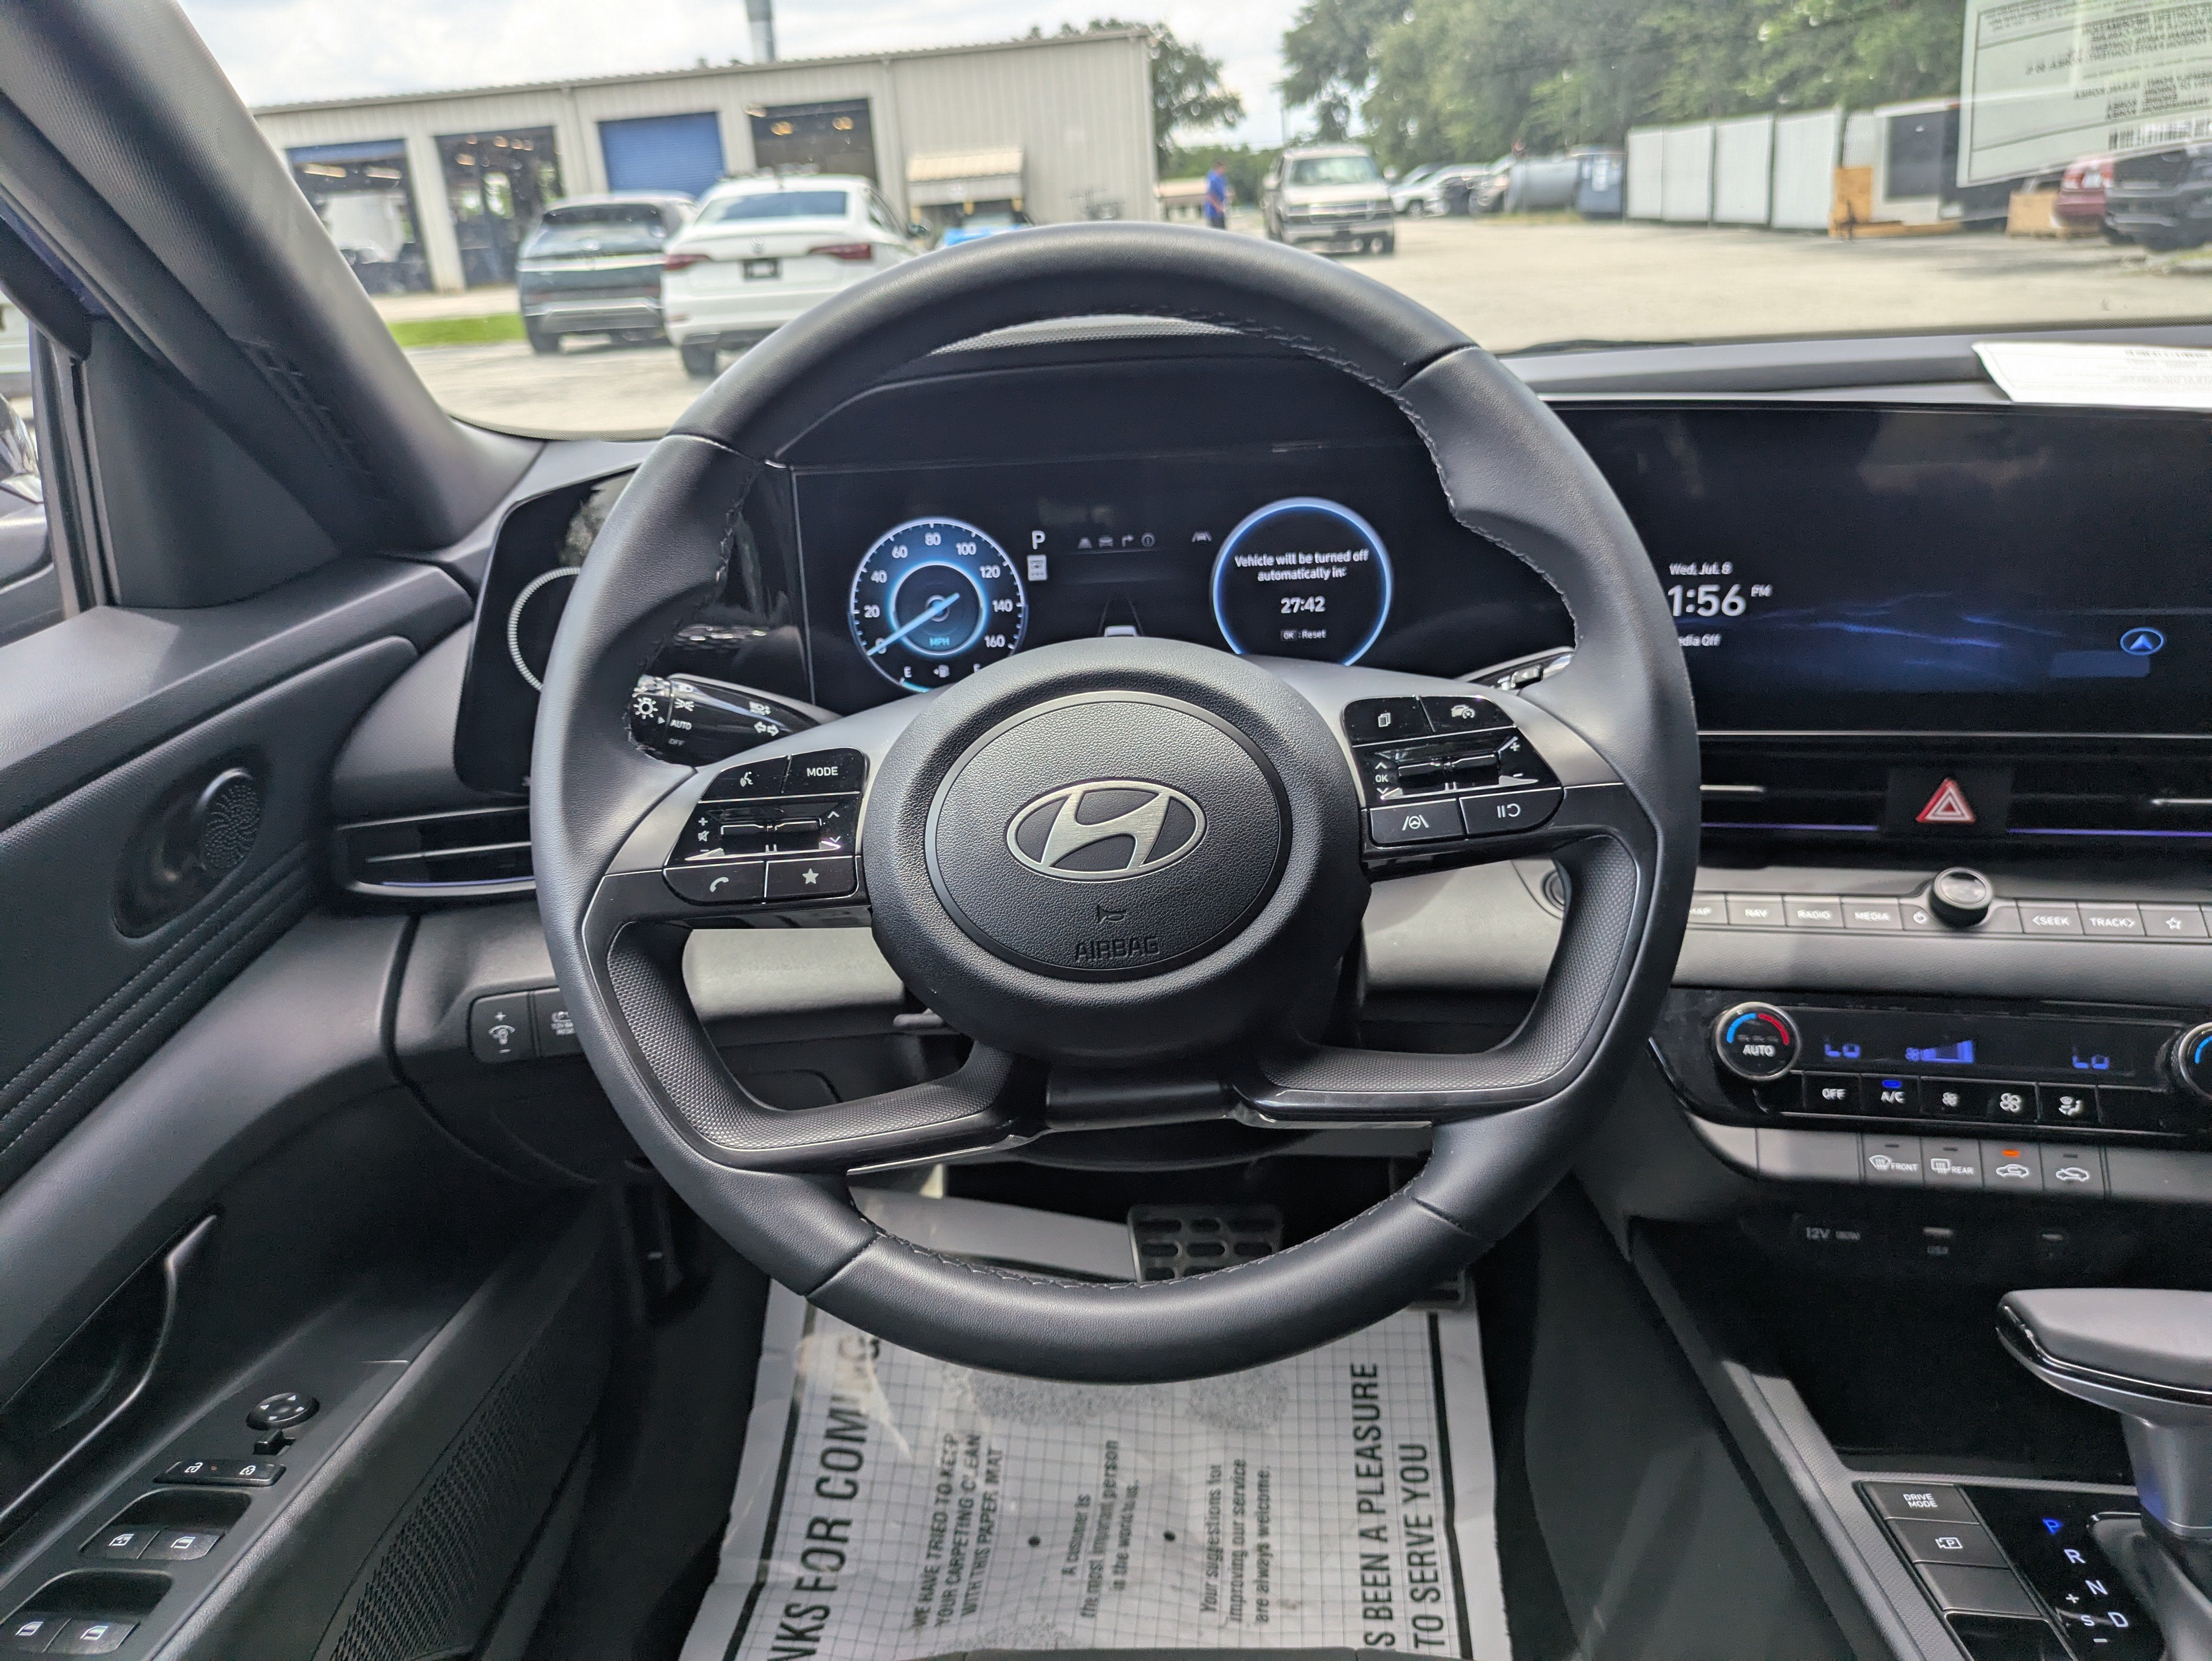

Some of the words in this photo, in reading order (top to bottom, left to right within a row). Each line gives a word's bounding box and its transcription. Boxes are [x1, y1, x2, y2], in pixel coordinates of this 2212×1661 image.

[925, 532, 941, 546] 80
[1032, 530, 1045, 550] P
[892, 545, 908, 559] 60
[956, 542, 977, 556] 100
[1235, 553, 1274, 568] Vehicle
[1276, 552, 1297, 565] will
[1299, 552, 1313, 565] be
[1315, 550, 1351, 564] turned
[1353, 548, 1369, 562] off
[871, 570, 887, 584] 40
[980, 565, 1000, 579] 120
[1258, 567, 1330, 582] automatically
[1722, 562, 1733, 575] 8
[992, 599, 1013, 613] 140
[1281, 596, 1326, 614] 27:42
[1668, 584, 1747, 617] 1:56
[1751, 584, 1772, 597] PM
[864, 605, 880, 619] 20
[929, 635, 950, 647] MPH
[984, 635, 1006, 649] 160
[1702, 633, 1721, 646] Off
[904, 666, 912, 678] E
[670, 719, 692, 730] AUTO
[807, 766, 839, 777] MODE
[1375, 775, 1388, 783] OK
[1745, 908, 1768, 918] NAV
[1797, 910, 1831, 920] RADIO
[1855, 911, 1890, 921] MEDIA
[1076, 936, 1160, 963] AIRBAG
[1743, 1044, 1775, 1057] AUTO
[1822, 1088, 1846, 1100] OFF
[1880, 1091, 1905, 1104] A/C
[1890, 1162, 1919, 1172] FRONT
[1950, 1166, 1974, 1175] REAR
[1349, 1362, 1387, 1516] PLEASURE
[984, 1447, 1003, 1485] MAT
[1206, 1463, 1223, 1485] for
[1398, 1443, 1431, 1505] YOU
[935, 1483, 953, 1506] TO
[1233, 1458, 1247, 1516] service
[1256, 1465, 1271, 1538] welcome.
[1908, 1500, 1938, 1508] MODE
[976, 1490, 999, 1547] PAPER
[2042, 1518, 2063, 1535] P
[926, 1511, 949, 1561] TRIED
[1080, 1596, 1099, 1619] the
[1102, 1440, 1120, 1500] person
[1205, 1487, 1224, 1579] suggestions
[1232, 1521, 1245, 1546] our
[1359, 1524, 1388, 1545] A
[793, 1516, 853, 1593] FOR
[935, 1591, 957, 1628] YOUR
[946, 1497, 975, 1586] CARPETING
[970, 1547, 991, 1579] THIS
[1403, 1513, 1441, 1605] SERVE
[2064, 1549, 2086, 1564] R
[1061, 1565, 1077, 1576] A
[1255, 1541, 1273, 1595] always
[918, 1564, 941, 1603] HAVE
[1229, 1549, 1248, 1623] improving
[1360, 1554, 1394, 1621] BEEN
[2085, 1580, 2108, 1595] N
[961, 1579, 982, 1617] WITH
[1200, 1580, 1218, 1614] Your
[912, 1606, 930, 1628] WE
[1255, 1597, 1270, 1624] are
[2080, 1614, 2095, 1627] S
[2108, 1612, 2129, 1628] D
[1411, 1614, 1445, 1649] TO
